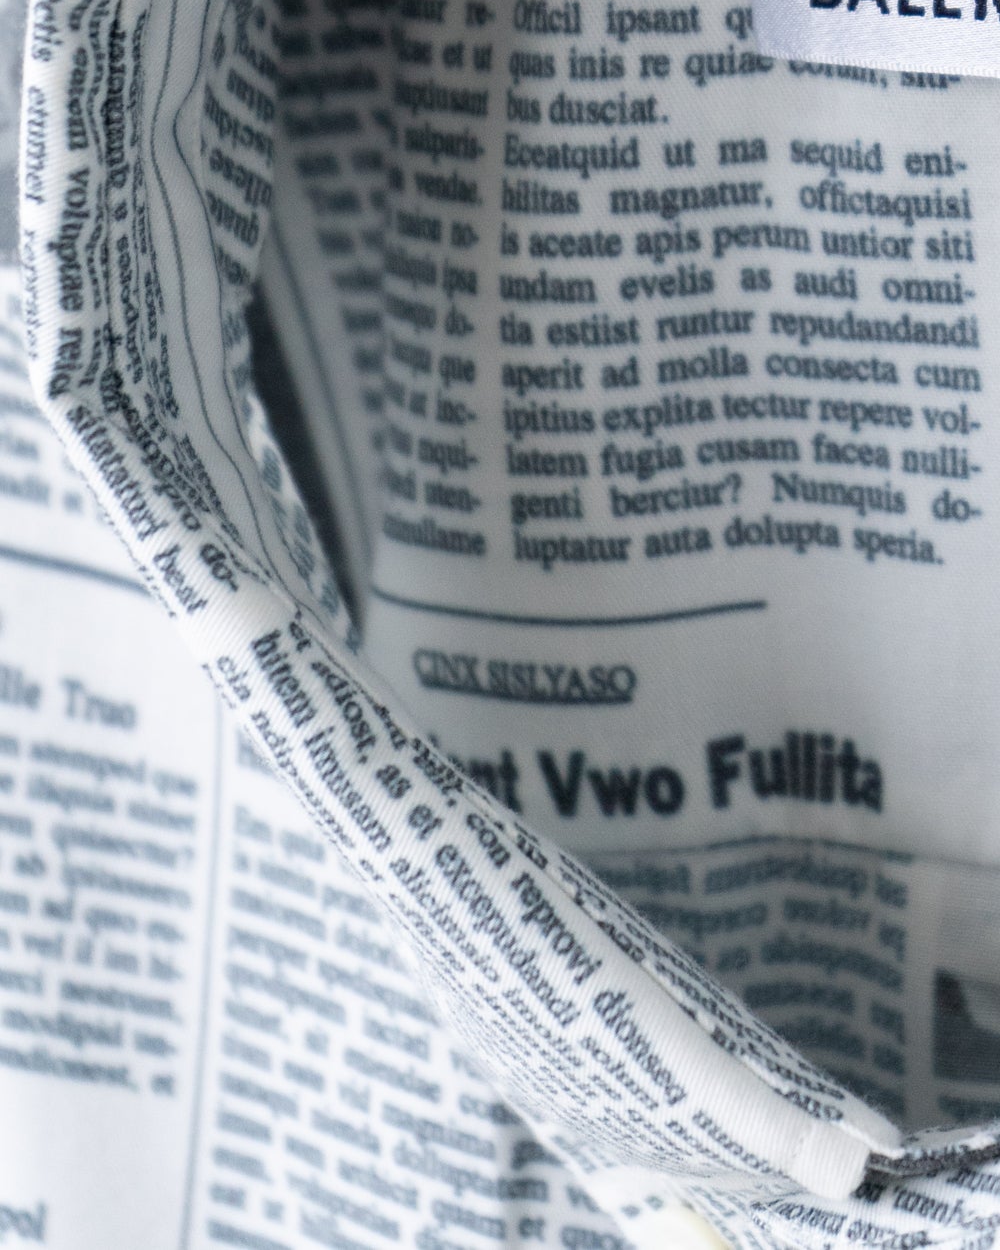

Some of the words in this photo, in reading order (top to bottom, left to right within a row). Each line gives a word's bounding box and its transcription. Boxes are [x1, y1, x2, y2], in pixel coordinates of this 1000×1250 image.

[606, 1, 701, 42] ipsant
[568, 46, 625, 82] inis
[640, 52, 671, 80] re
[507, 88, 542, 124] bus
[549, 90, 669, 126] dusciat.
[663, 138, 696, 169] ut
[718, 136, 768, 166] ma
[790, 138, 884, 178] sequid
[904, 145, 968, 178] eni-
[609, 180, 774, 221] magnatur,
[47, 165, 91, 314] voluptae
[529, 229, 622, 258] aceate
[635, 221, 702, 264] apis
[712, 223, 811, 260] perum
[821, 225, 914, 261] untior
[924, 227, 975, 262] siti
[499, 268, 598, 303] undam
[619, 263, 715, 301] evelis
[740, 266, 772, 292] as
[794, 267, 858, 301] audi
[881, 271, 976, 305] omni-
[500, 311, 534, 346] tia
[655, 307, 754, 342] runtur
[768, 309, 981, 349] repudandandi
[502, 357, 585, 397] aperit
[601, 354, 641, 390] ad
[657, 346, 749, 386] molla
[765, 353, 899, 385] consecta
[914, 363, 982, 393] cum
[503, 399, 596, 440] ipitius
[602, 392, 715, 438] explita
[721, 391, 812, 421] tectur
[817, 398, 915, 433] repere
[922, 401, 982, 436] vol-
[600, 438, 686, 482] fugia
[696, 438, 801, 467] cusam
[811, 432, 891, 471] facea
[901, 447, 982, 480] nulli-
[511, 484, 584, 526] genti
[609, 471, 743, 519] berciur?
[771, 471, 907, 518] Numquis
[930, 488, 982, 523] do-
[199, 542, 239, 592] do-
[512, 526, 633, 572] luptatur
[644, 525, 714, 558] auta
[722, 513, 842, 554] dolupta
[852, 526, 945, 565] speria.
[536, 749, 685, 817] Vwo
[706, 728, 885, 814] Fullita
[376, 764, 413, 801] as
[406, 801, 446, 841] et
[465, 811, 512, 869] con
[510, 870, 604, 985] reprovi
